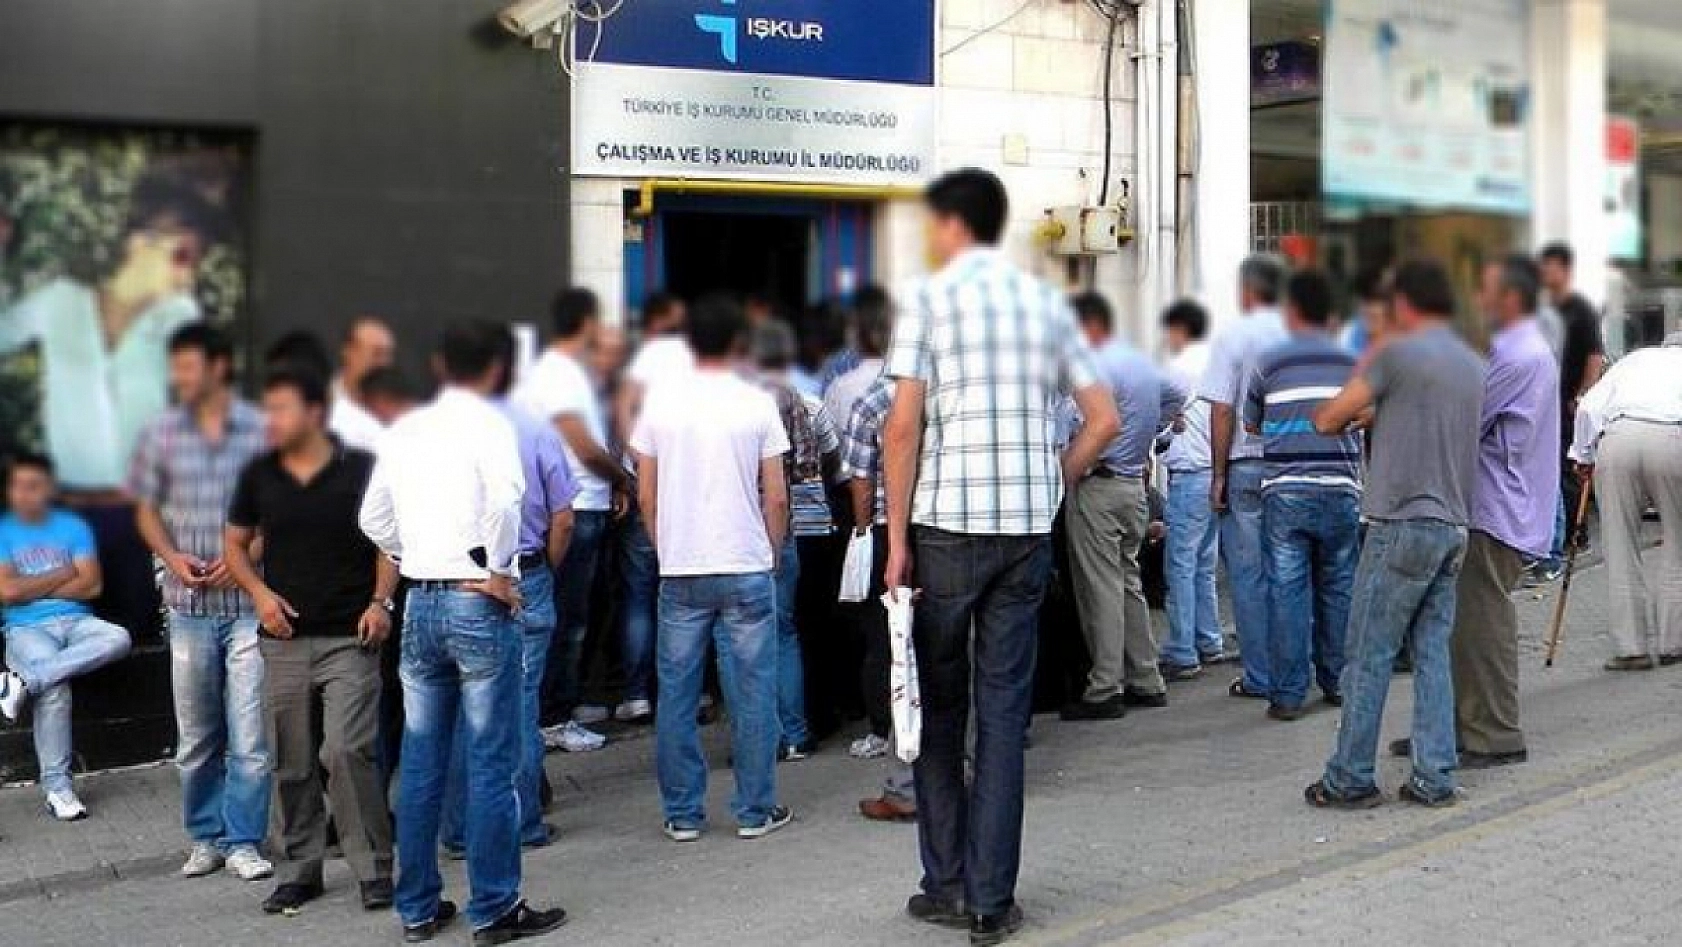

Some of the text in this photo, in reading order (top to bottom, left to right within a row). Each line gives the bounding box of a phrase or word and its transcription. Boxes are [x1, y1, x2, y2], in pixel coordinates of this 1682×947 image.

[703, 103, 763, 120] KURUMU
[766, 107, 811, 124] GENEL
[597, 141, 674, 164] ÇALIŞMA
[677, 145, 701, 163] VE
[705, 145, 721, 165] İŞ
[726, 147, 798, 167] KURUMU
[801, 148, 815, 167] İL
